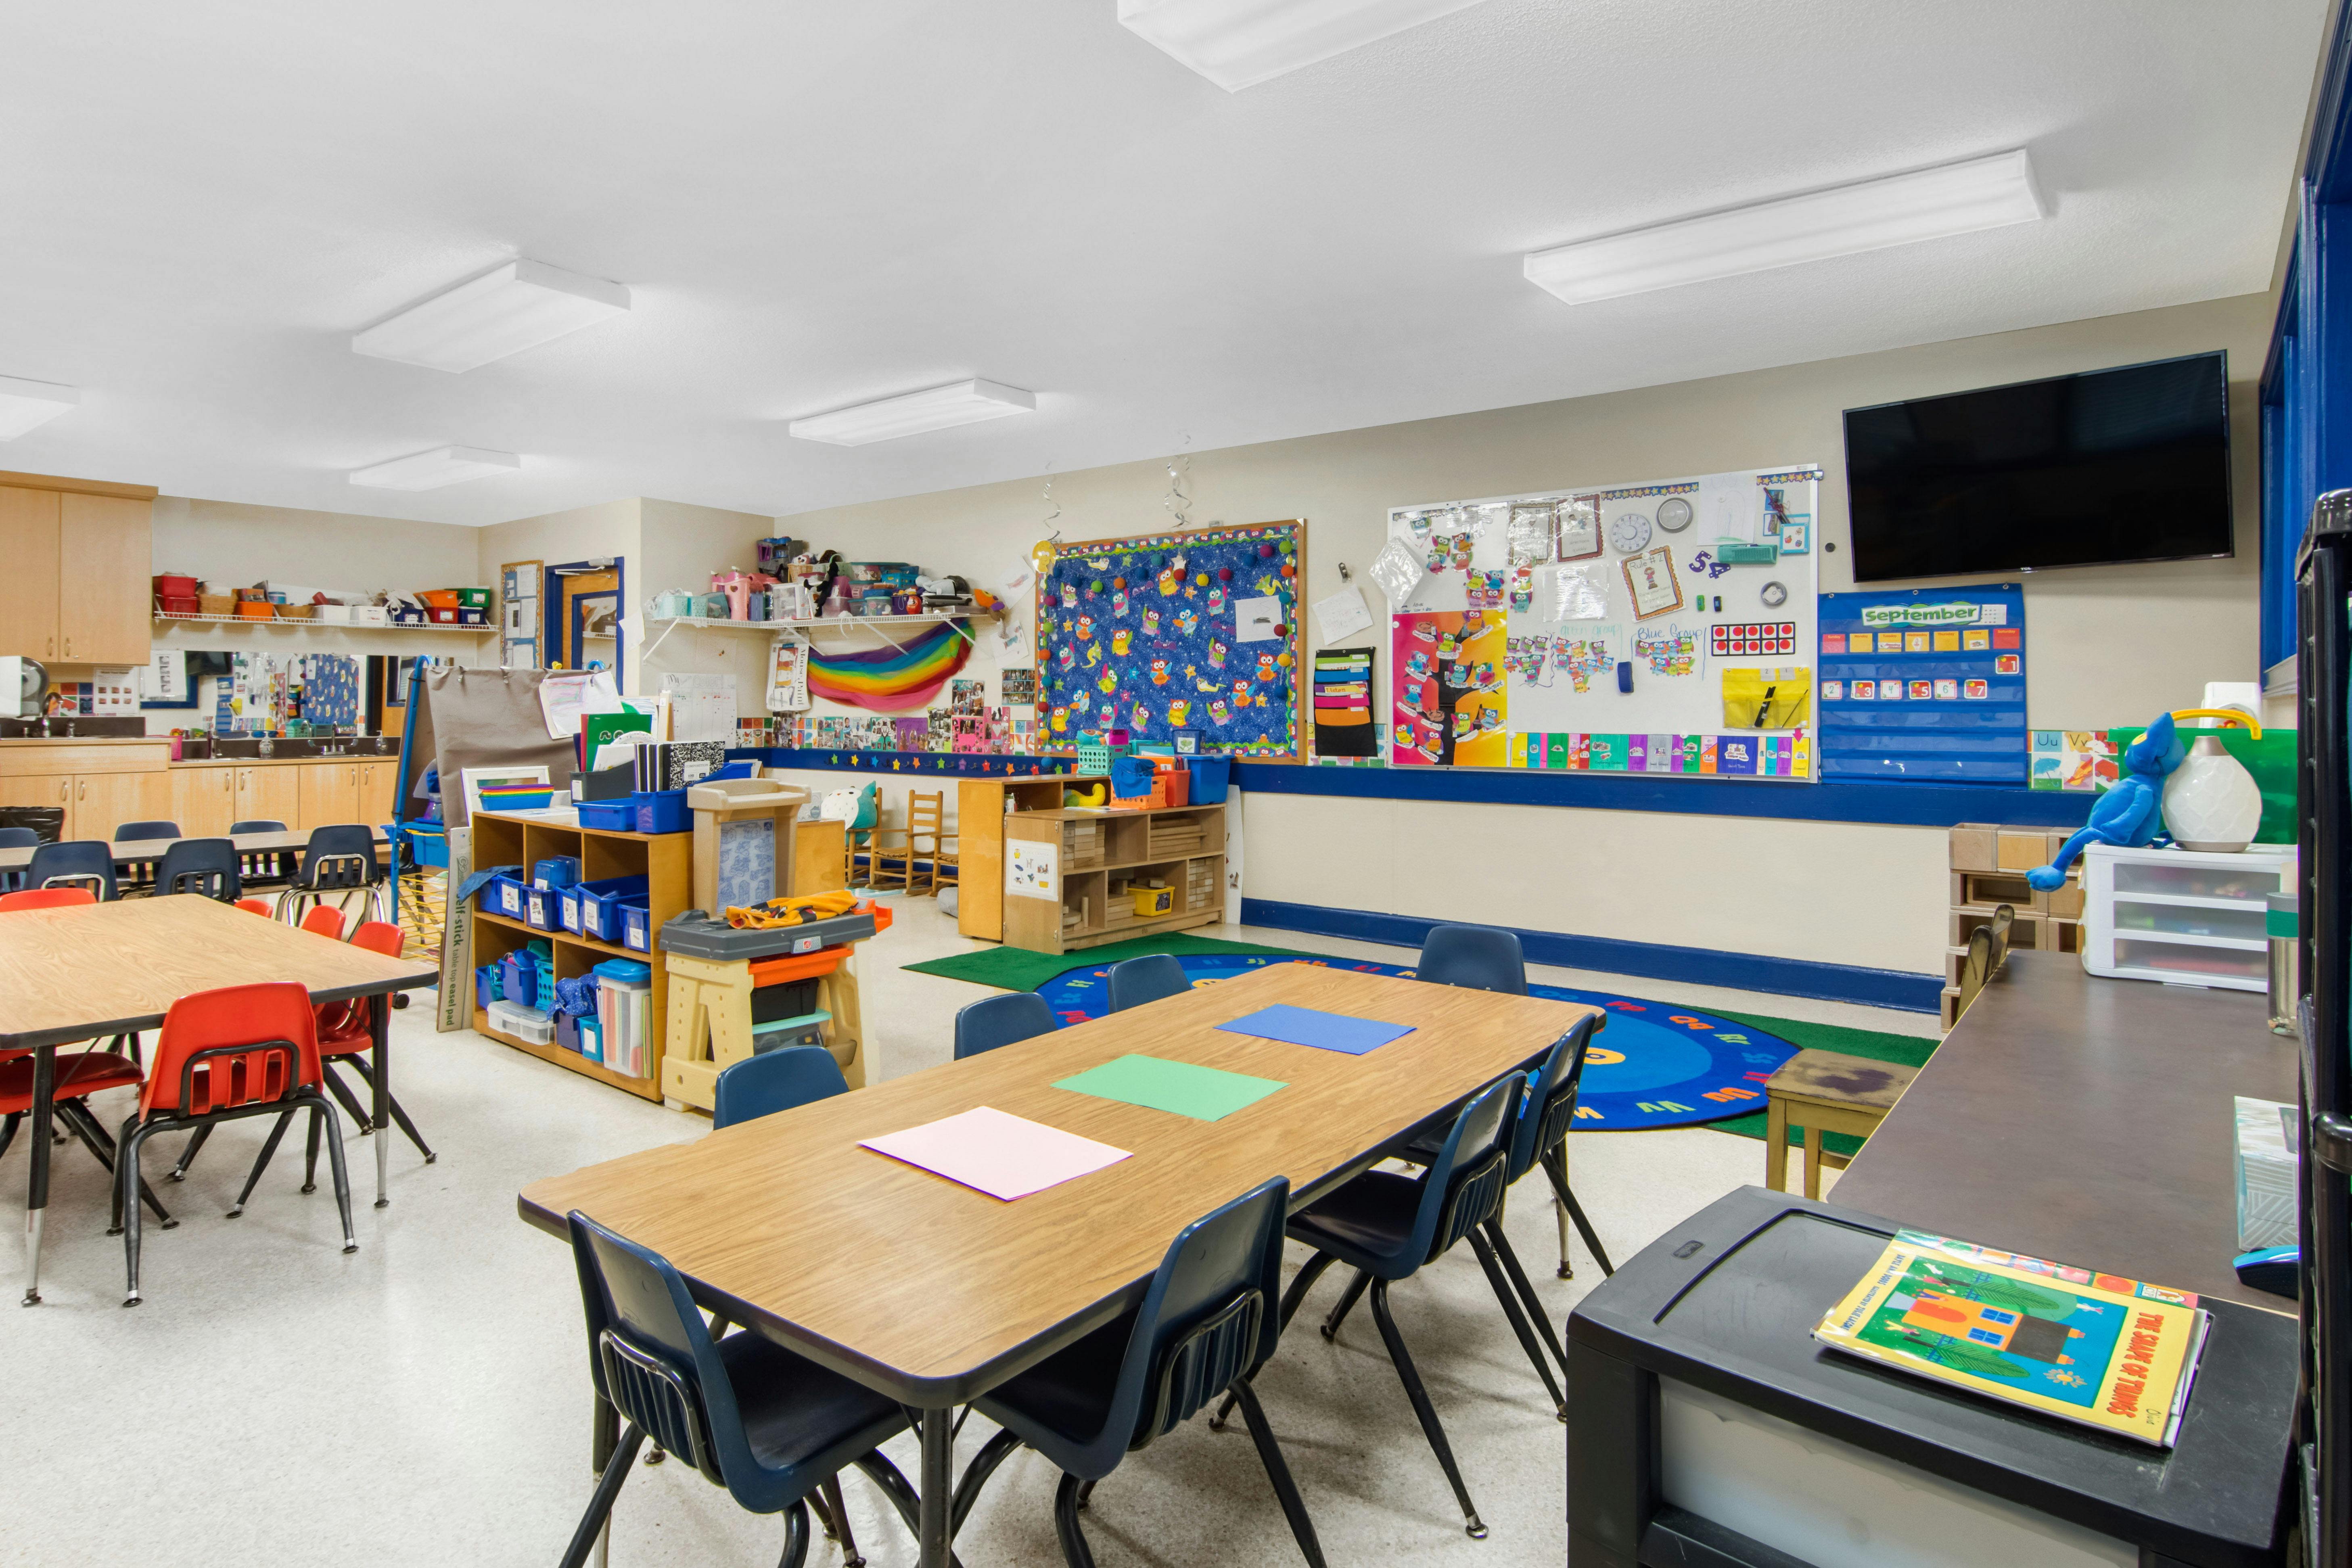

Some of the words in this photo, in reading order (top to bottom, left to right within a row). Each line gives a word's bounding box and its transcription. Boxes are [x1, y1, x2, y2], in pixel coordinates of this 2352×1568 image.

[1629, 560, 1646, 569] Rule
[1659, 554, 1664, 562] 2
[1688, 550, 1712, 572] 5
[1708, 562, 1731, 579] 4
[1865, 606, 1976, 623] September
[1182, 623, 1195, 632] Julian
[1638, 627, 1664, 640] Blue
[1670, 623, 1702, 640] Group
[2011, 661, 2015, 671] 1
[665, 674, 680, 687] My
[693, 675, 724, 689] Color!
[1829, 686, 1834, 694] 2
[1864, 687, 1871, 696] 3
[1888, 685, 1893, 694] 4
[1921, 686, 1928, 696] 5
[1943, 685, 1948, 694] 6
[1977, 686, 1984, 696] 7
[2037, 733, 2059, 747] Uu
[2071, 734, 2089, 746] Vv
[453, 893, 466, 947] elf-stick
[452, 949, 460, 968] table
[449, 969, 458, 982] top
[448, 984, 456, 1007] easel
[1536, 991, 1578, 1000] Oo
[1606, 1001, 1646, 1012] Pp
[446, 1009, 454, 1026] pad
[1669, 1016, 1715, 1030] Qq
[1712, 1034, 1751, 1045] Rr
[1741, 1052, 1777, 1064] Ss
[1702, 1087, 1760, 1102] Uu
[1635, 1101, 1696, 1113] Vv
[1877, 1273, 1892, 1285] DODDS
[1854, 1305, 1866, 1319] JULIE
[2135, 1311, 2164, 1333] THE
[2124, 1330, 2160, 1364] SHAPE
[2119, 1363, 2149, 1379] OF
[2107, 1376, 2145, 1418] THINGS
[2146, 1409, 2162, 1425] Olivia
